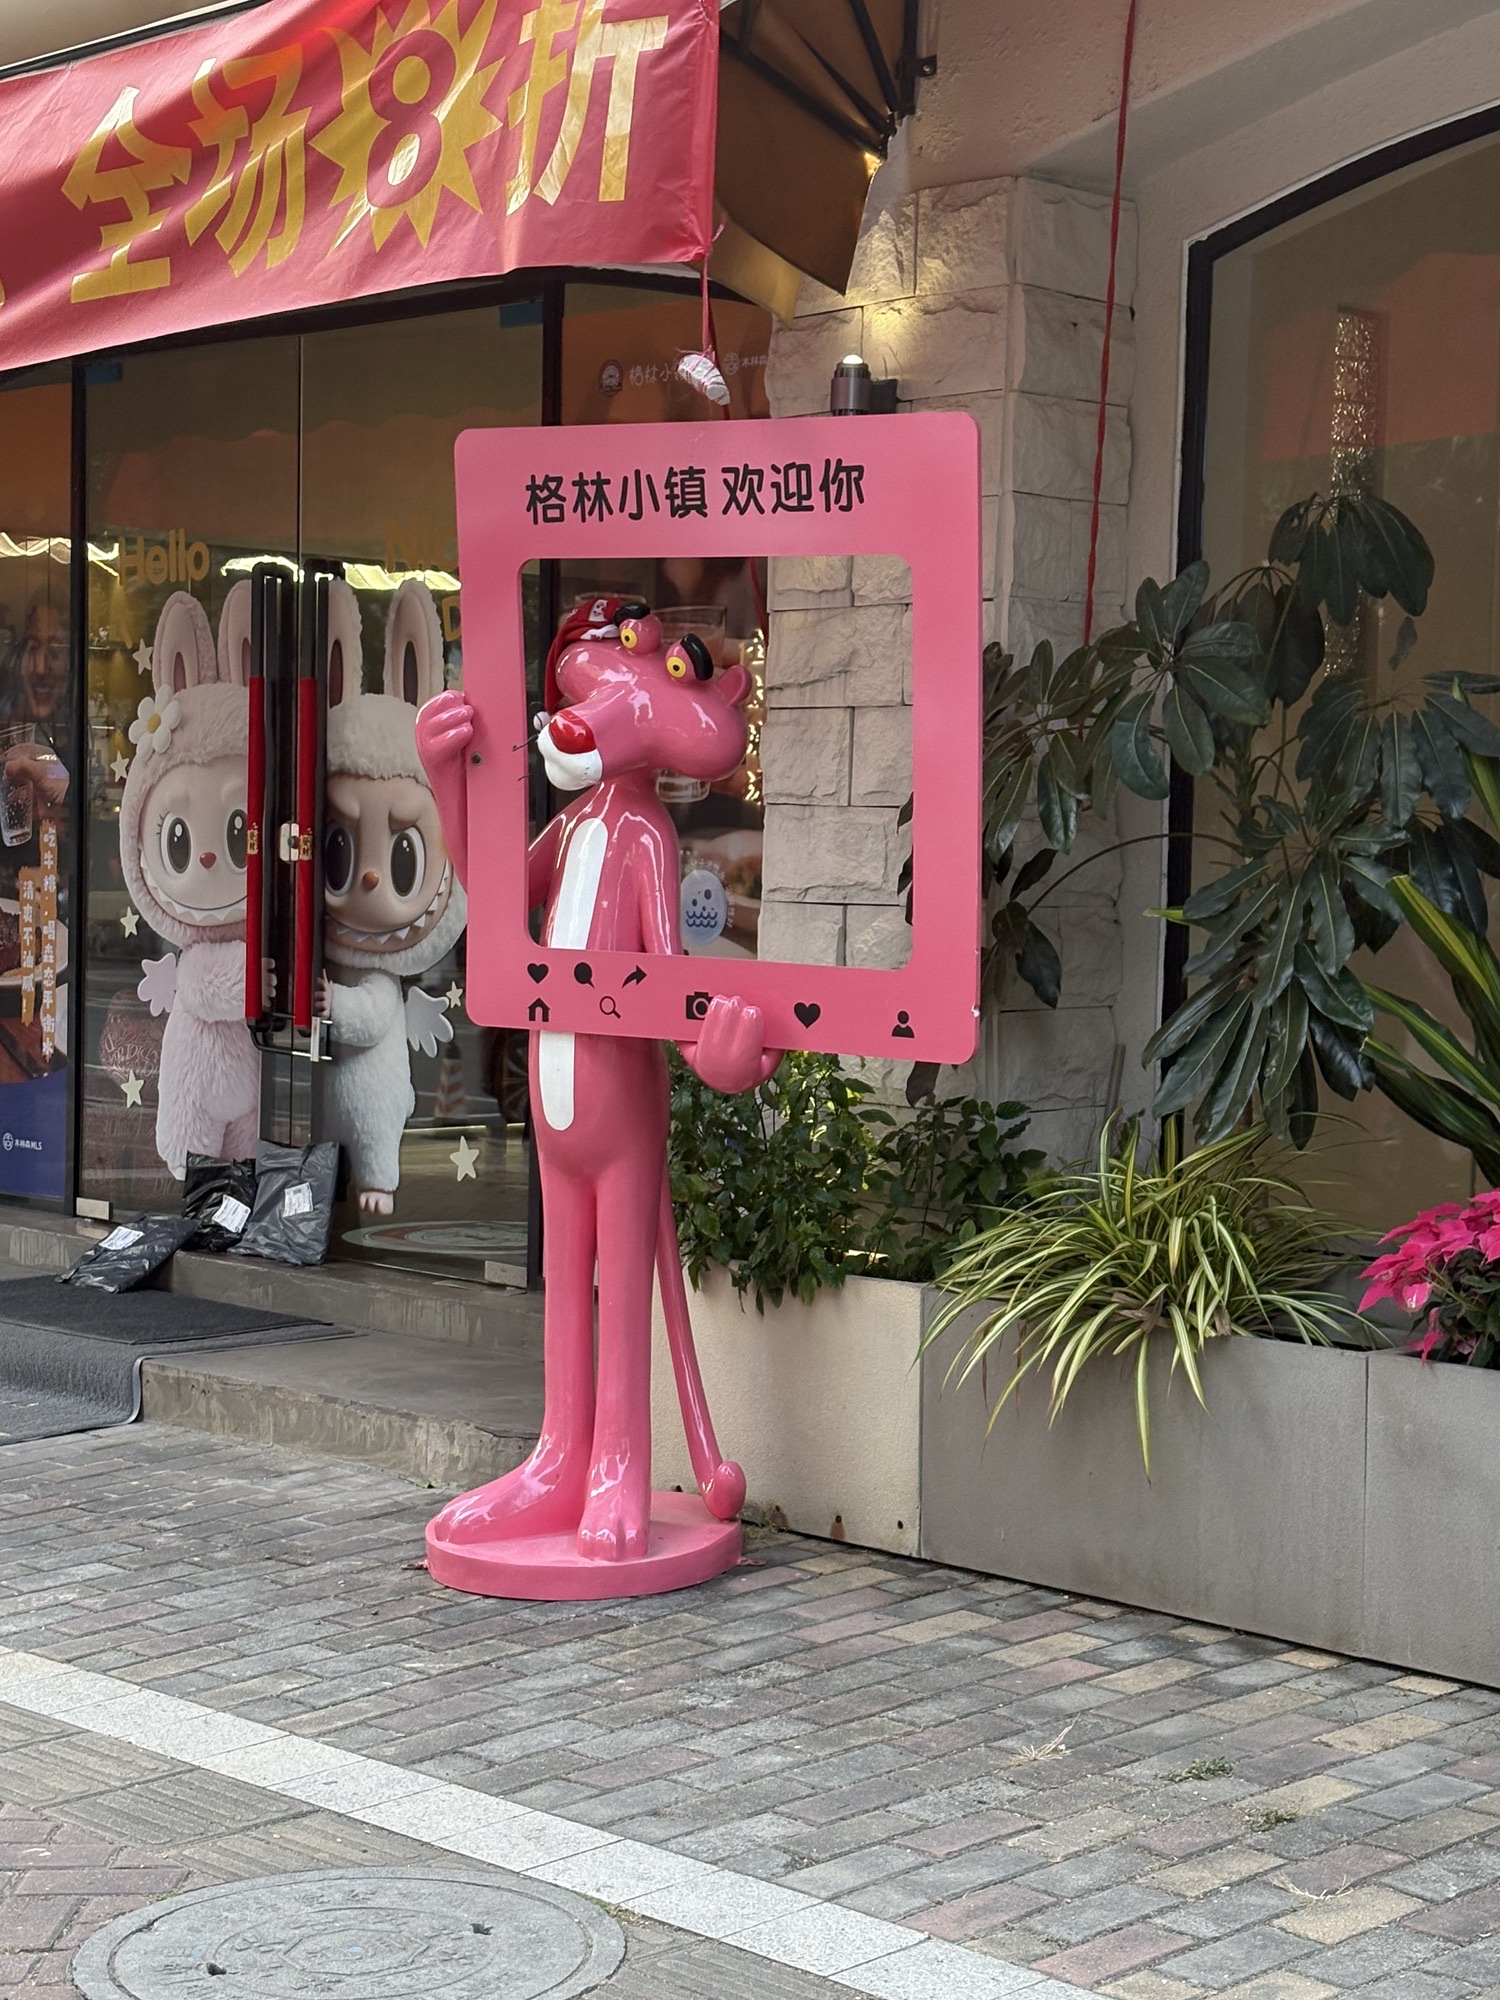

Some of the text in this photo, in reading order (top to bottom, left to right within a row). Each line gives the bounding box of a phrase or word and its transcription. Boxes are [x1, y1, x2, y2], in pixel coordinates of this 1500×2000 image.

[526, 457, 866, 526] 格林小镇 欢迎你
[118, 528, 211, 586] Hello
